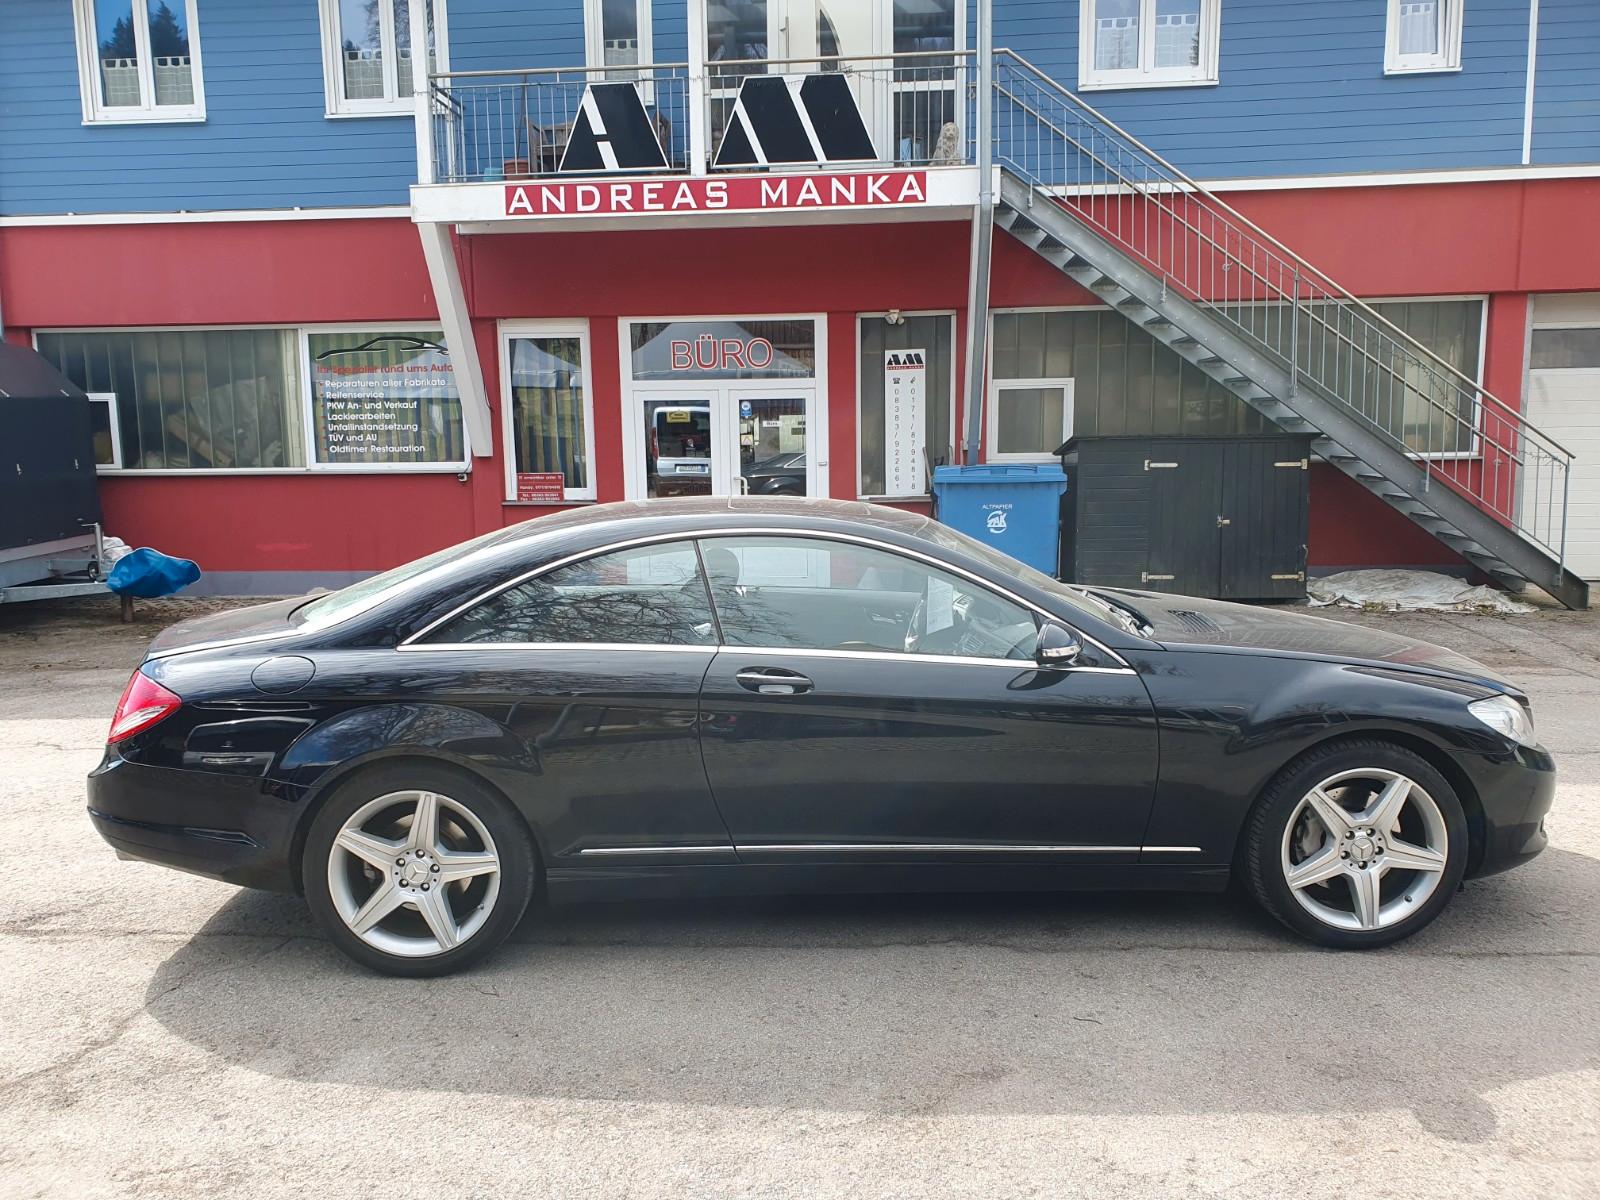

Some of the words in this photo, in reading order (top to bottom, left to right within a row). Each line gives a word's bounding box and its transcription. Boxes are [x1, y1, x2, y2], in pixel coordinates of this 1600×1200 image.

[508, 180, 729, 214] ANDREAS
[760, 173, 926, 207] MANKA
[671, 334, 773, 371] BÜRO
[381, 364, 404, 373] rund
[407, 365, 428, 373] ums
[325, 380, 380, 389] Reparaturen
[383, 379, 402, 387] aller
[404, 378, 446, 386] Fabrikate
[326, 391, 384, 399] Reifenservice
[327, 402, 345, 410] PKW
[347, 402, 362, 410] An-
[384, 401, 418, 409] Verkauf
[327, 412, 396, 420] Lackierarbeiten
[328, 423, 418, 431] Unfallinstandsetzung
[328, 433, 344, 441] TÜV
[329, 445, 368, 453] Oldtimer
[371, 444, 425, 452] Restauration
